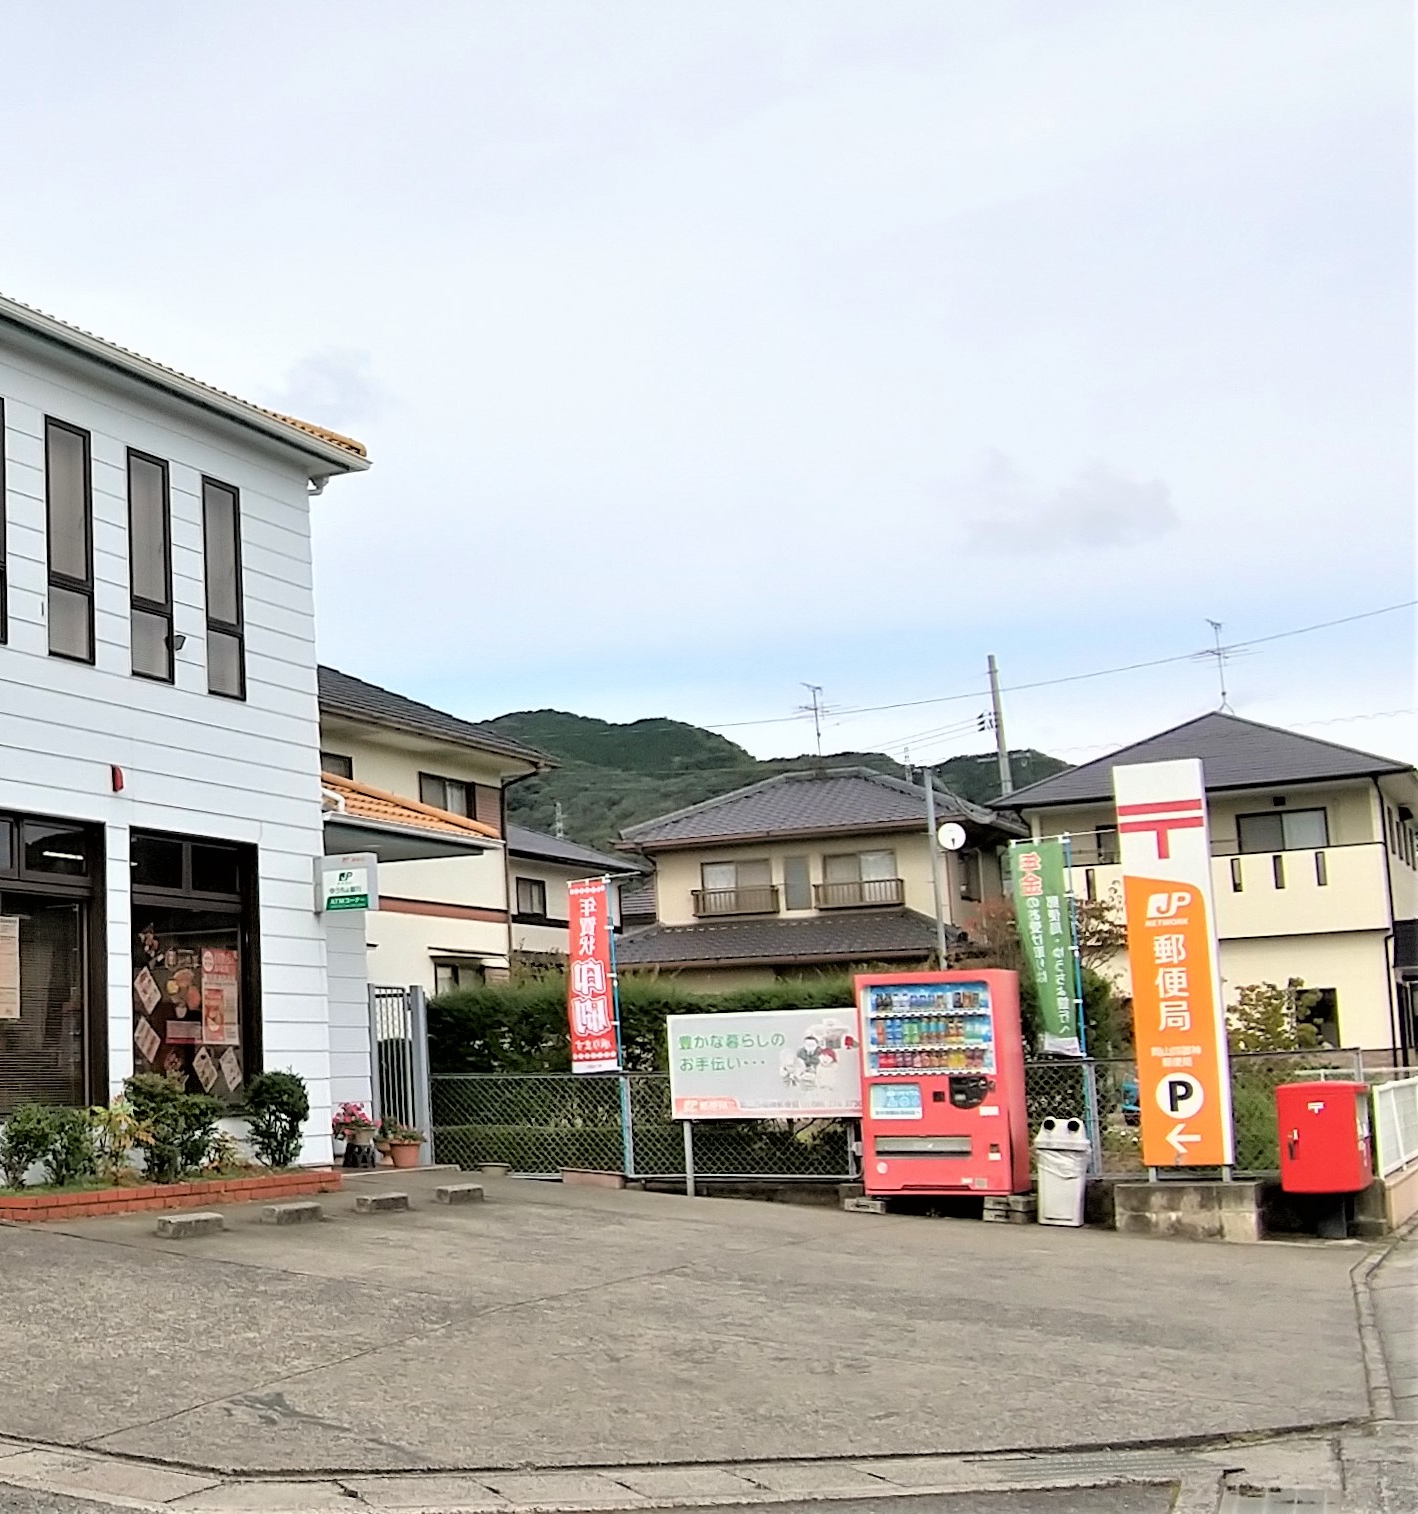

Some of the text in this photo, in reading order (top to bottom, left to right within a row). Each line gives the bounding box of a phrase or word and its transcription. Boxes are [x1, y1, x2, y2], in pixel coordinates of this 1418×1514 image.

[1146, 891, 1192, 918] JP
[1153, 934, 1191, 1032] 郵便局
[678, 1033, 786, 1051] 豊かな暮らしの
[1169, 1080, 1194, 1112] P
